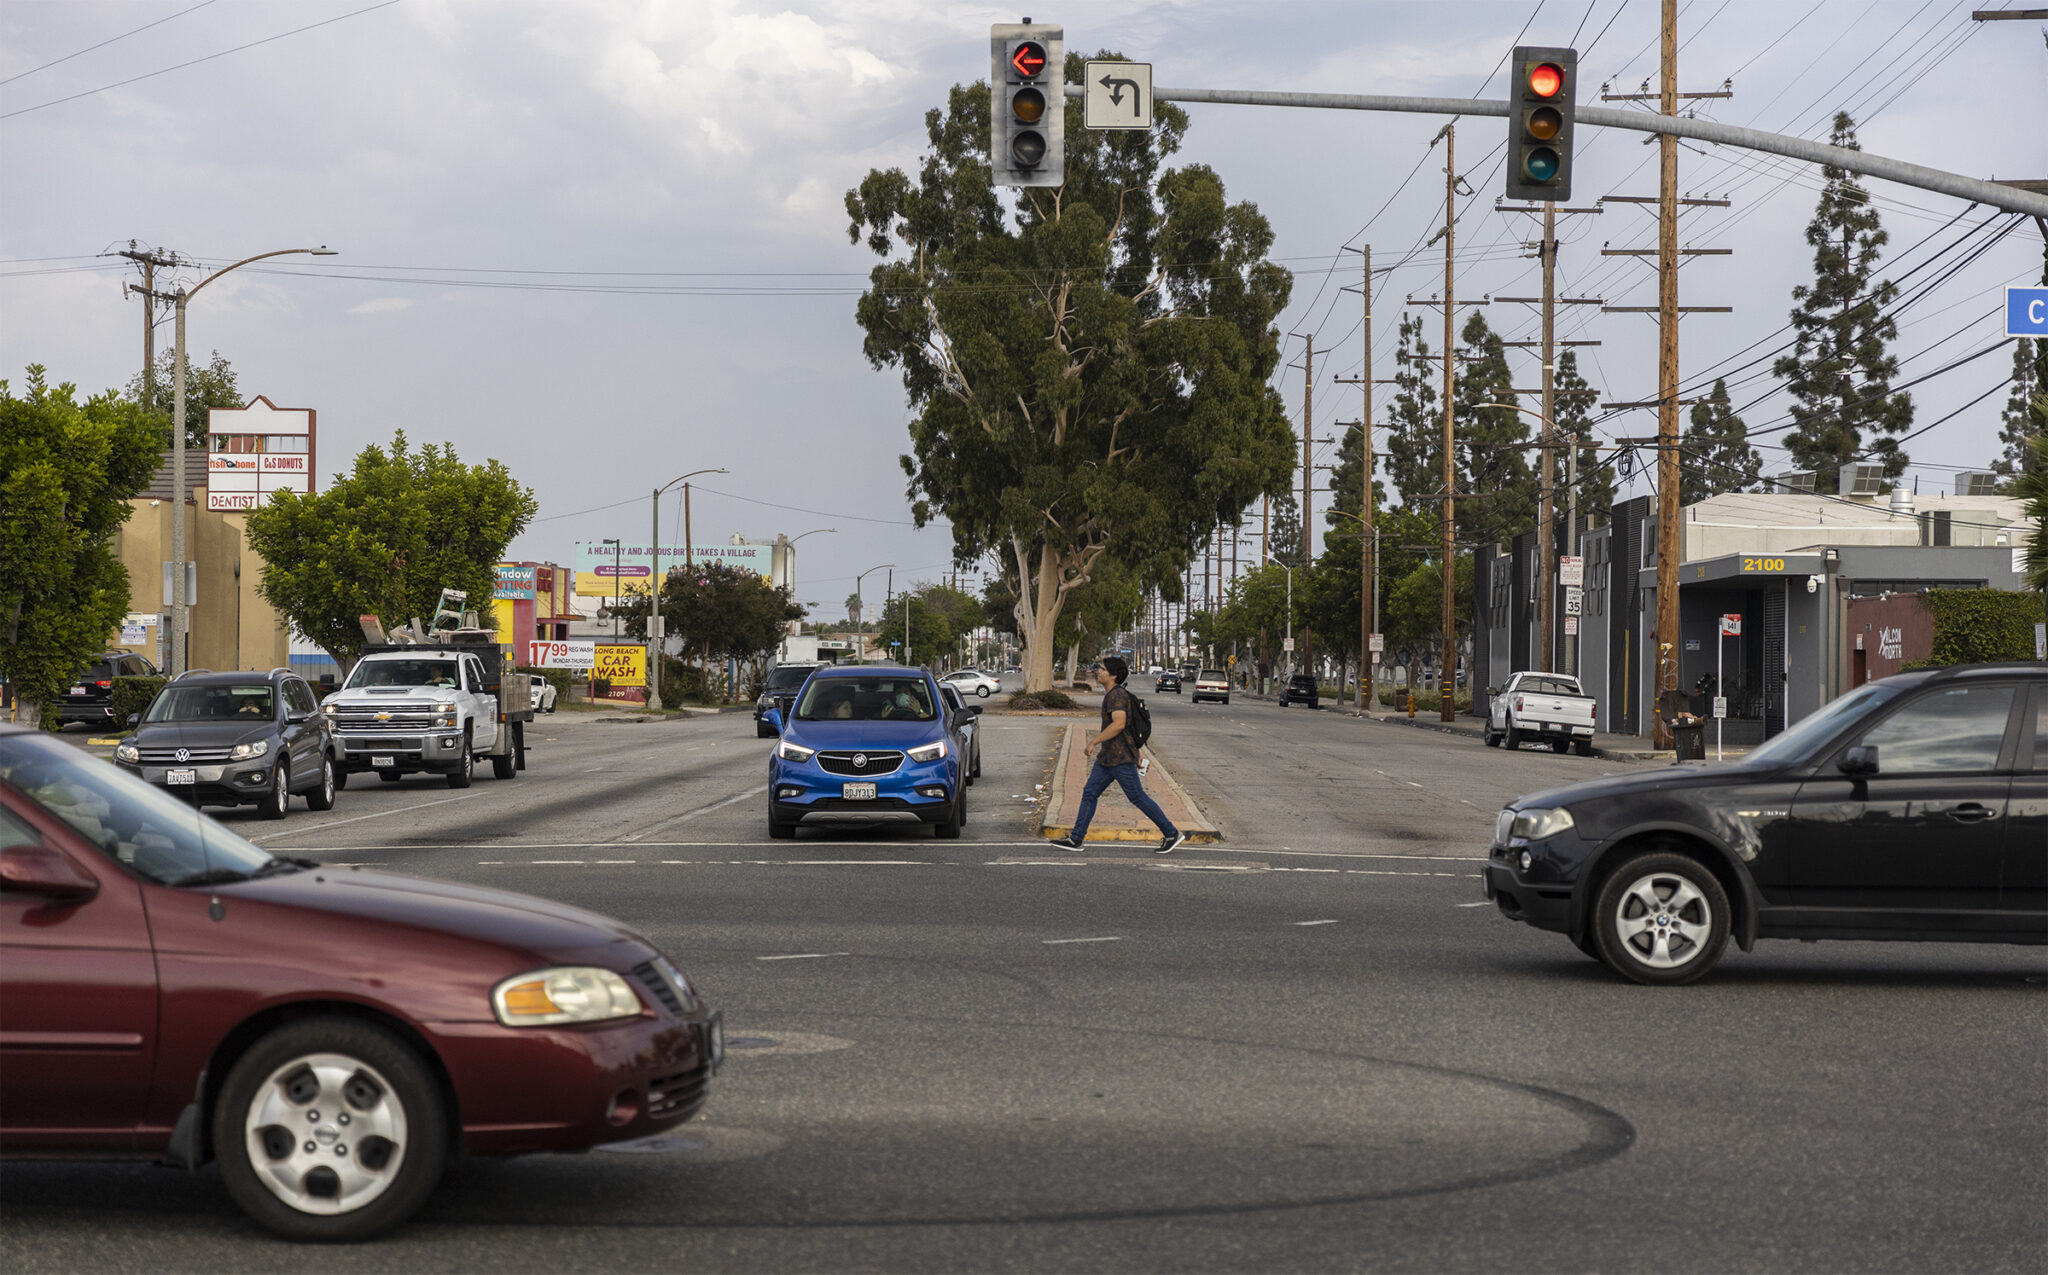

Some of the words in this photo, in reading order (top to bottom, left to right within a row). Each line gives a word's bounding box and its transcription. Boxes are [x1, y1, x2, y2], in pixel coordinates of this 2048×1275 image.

[2028, 299, 2045, 324] C
[235, 460, 256, 468] bone
[278, 458, 302, 469] DONUTS
[212, 496, 254, 507] DENTIST
[588, 547, 592, 555] A
[644, 548, 672, 556] JOOUS
[696, 548, 718, 556] TAKES
[727, 549, 756, 557] VILLAGE
[1744, 558, 1784, 571] 2100
[496, 580, 532, 590] NTING
[1568, 602, 1580, 612] 35
[602, 656, 630, 666] CAR
[597, 667, 636, 678] WASH
